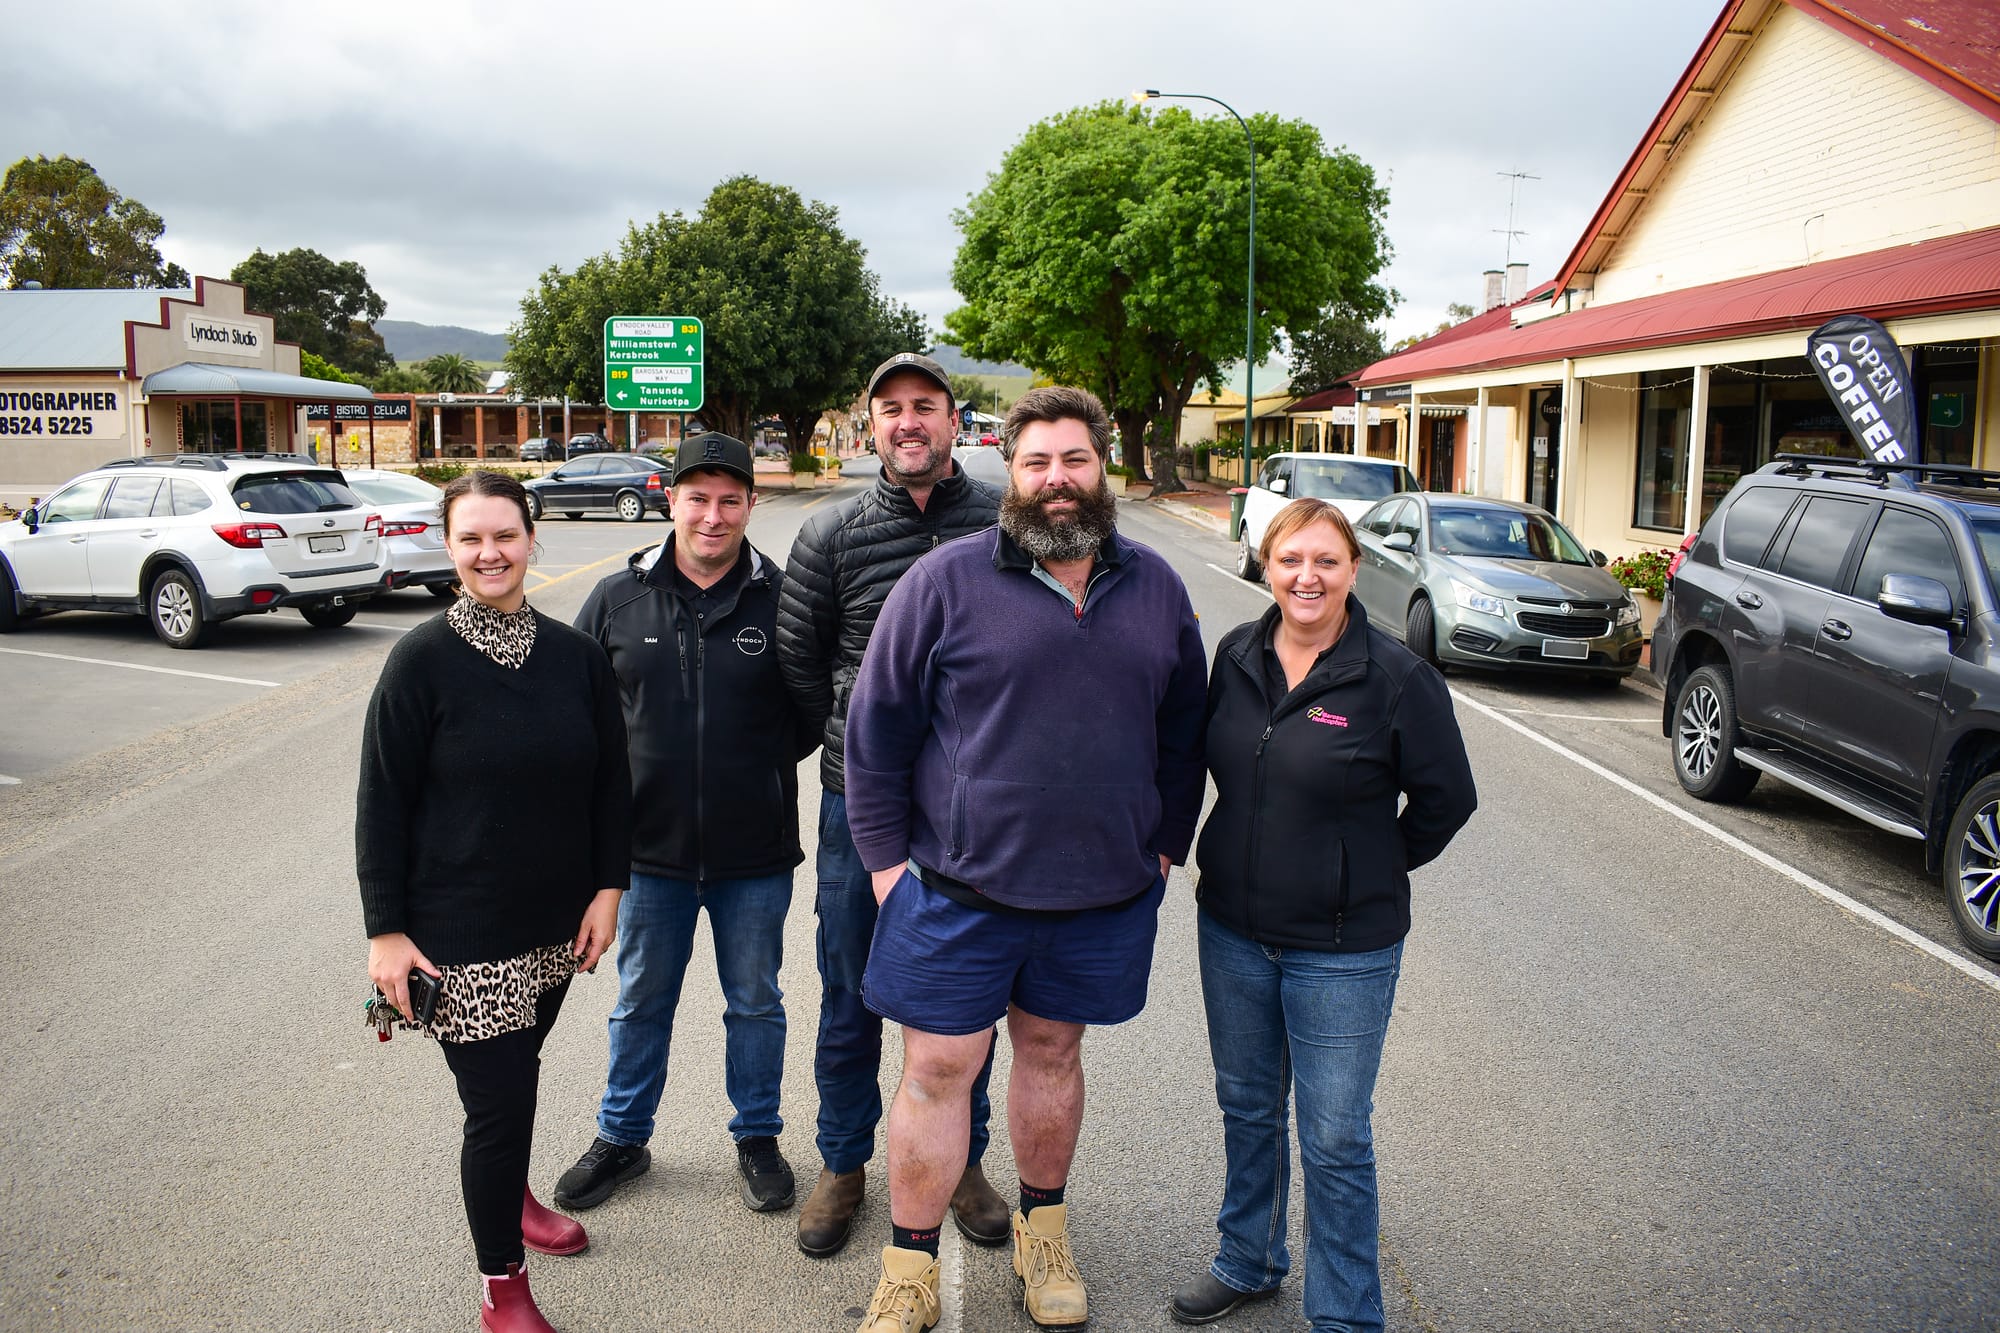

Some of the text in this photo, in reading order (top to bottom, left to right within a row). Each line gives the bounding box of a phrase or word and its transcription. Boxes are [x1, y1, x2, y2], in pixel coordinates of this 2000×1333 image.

[191, 322, 257, 347] Lyndoch Studio
[681, 325, 698, 334] B31
[609, 339, 677, 349] Williamstown
[609, 350, 659, 359] Kersbrook
[1849, 335, 1902, 403] OPEN
[611, 370, 629, 379] B19
[640, 386, 684, 395] Tanunda
[640, 397, 689, 407] Nuriootpa
[1815, 343, 1905, 463] COFFEE
[307, 405, 407, 415] CAFE BISTRO CELLAR
[0, 416, 93, 435] 8524 5225
[1311, 715, 1349, 728] Helicopters
[1322, 711, 1347, 722] Barossa
